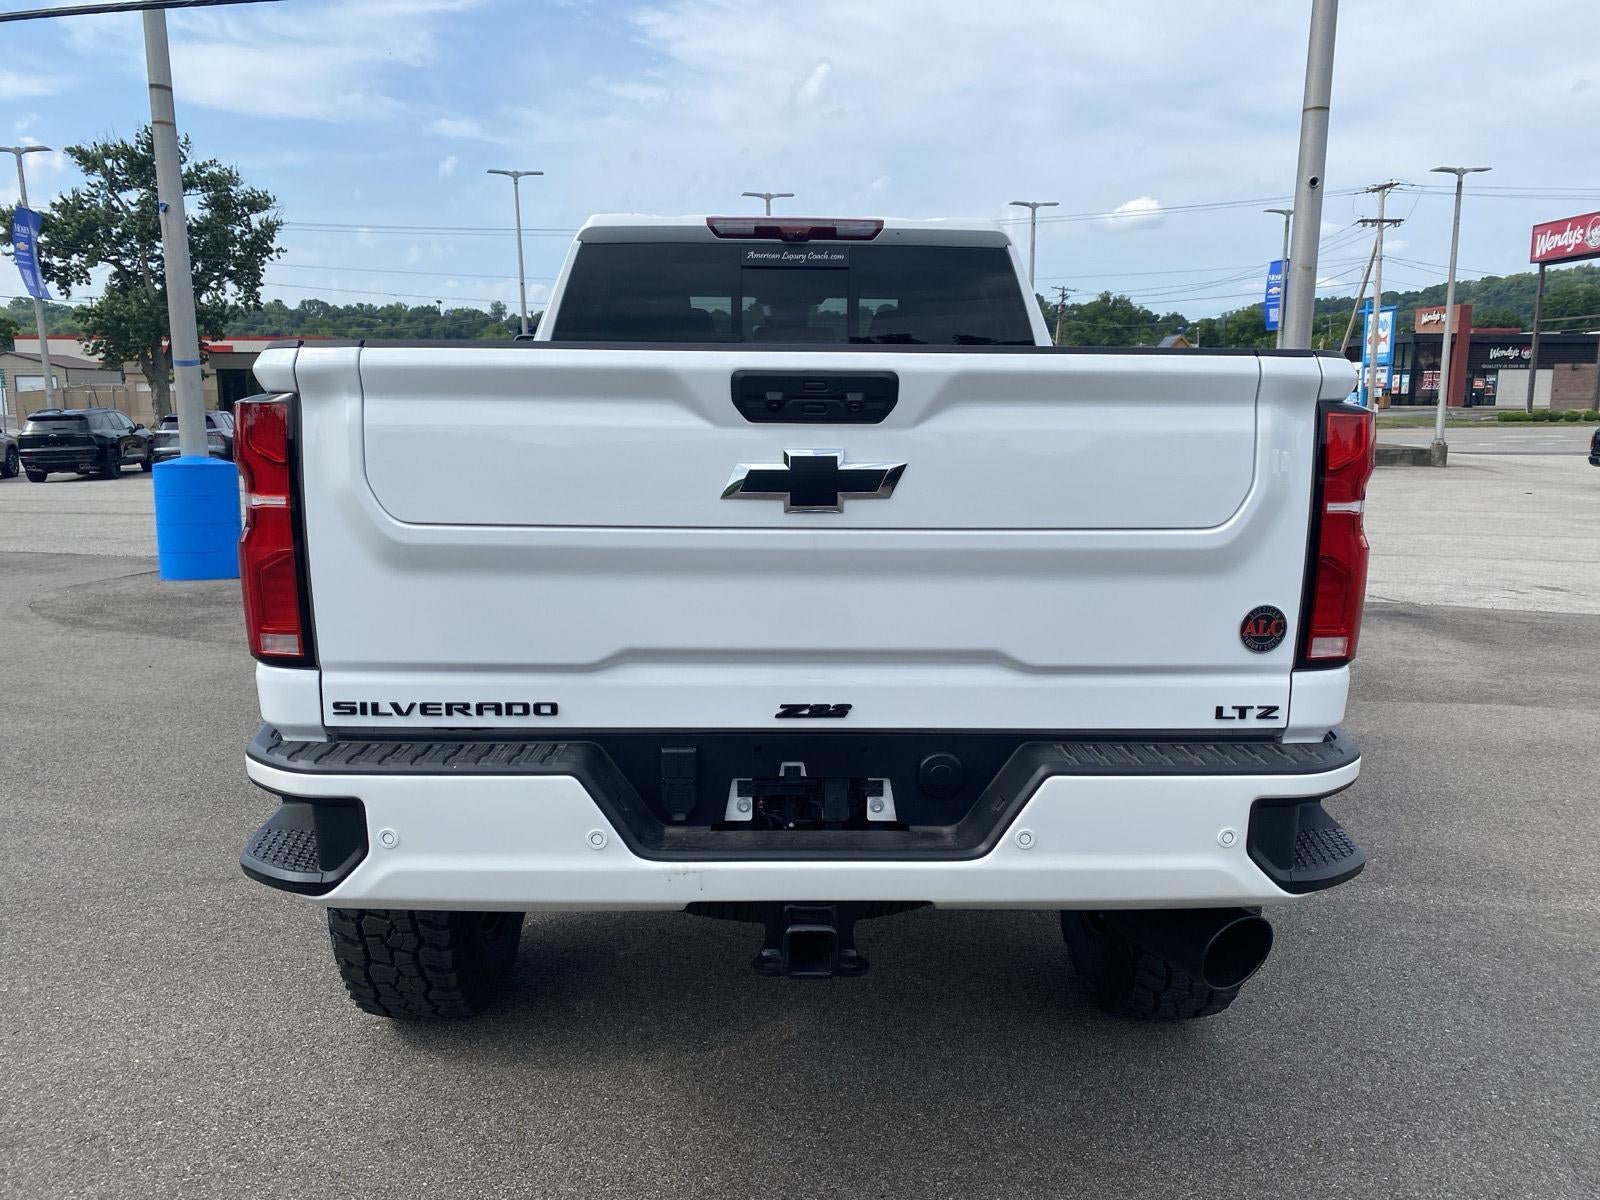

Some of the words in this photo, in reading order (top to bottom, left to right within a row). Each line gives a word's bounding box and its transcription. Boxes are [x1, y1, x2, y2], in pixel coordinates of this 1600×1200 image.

[1535, 222, 1584, 258] Wendy's
[746, 251, 780, 259] American
[781, 251, 807, 264] Luxury
[807, 250, 845, 260] Coach.com
[1489, 346, 1520, 360] Wendy's
[1242, 619, 1284, 636] ALC
[332, 701, 559, 716] SILVERADO
[1214, 705, 1280, 720] LTZ
